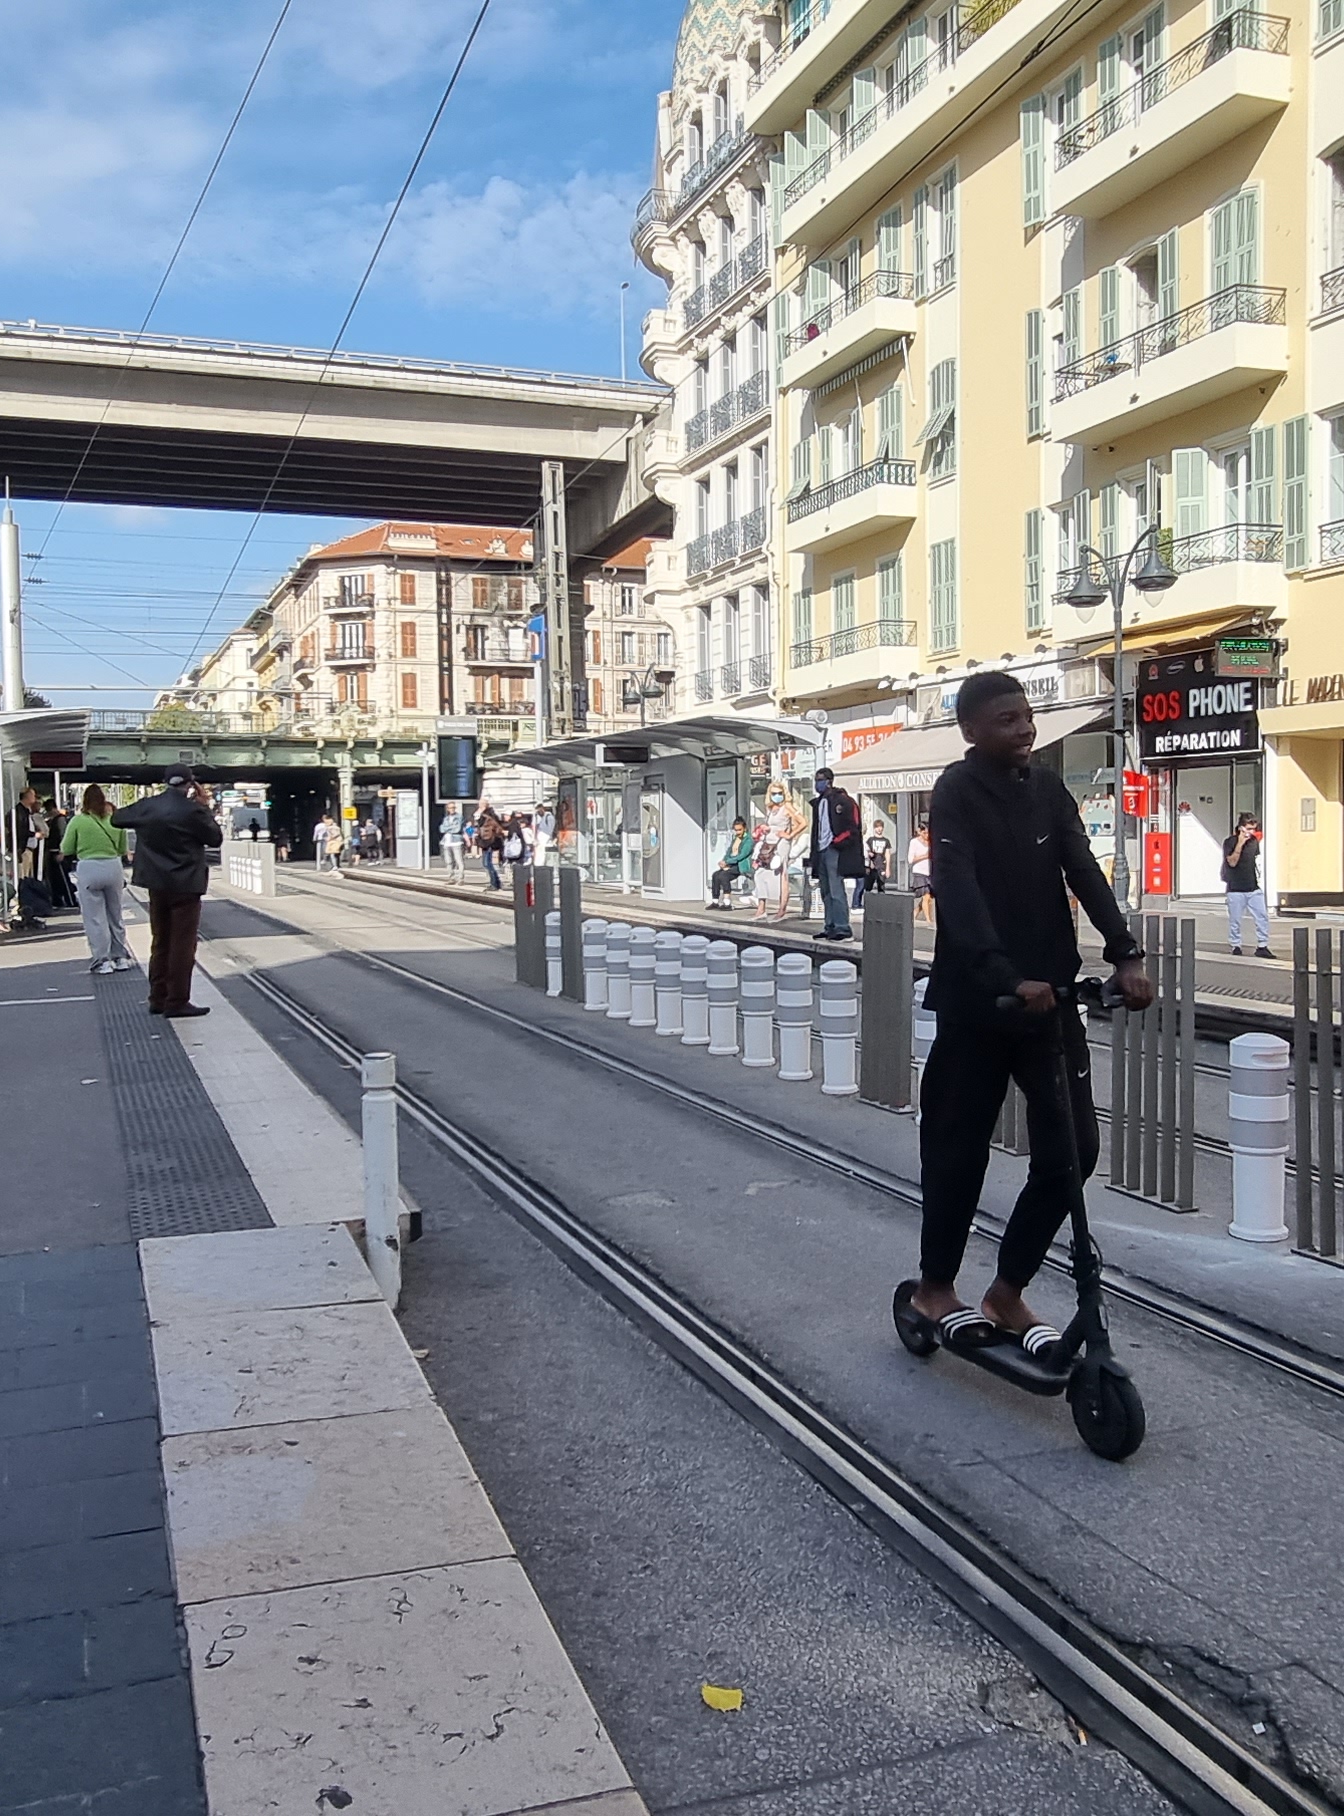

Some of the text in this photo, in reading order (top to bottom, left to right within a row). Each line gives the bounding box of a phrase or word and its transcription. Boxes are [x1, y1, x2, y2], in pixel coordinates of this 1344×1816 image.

[1142, 681, 1254, 722] SOS PHONE
[843, 737, 853, 752] 04
[854, 735, 865, 751] 93
[1155, 729, 1241, 753] RÉPARATION
[859, 776, 896, 790] AUDITION
